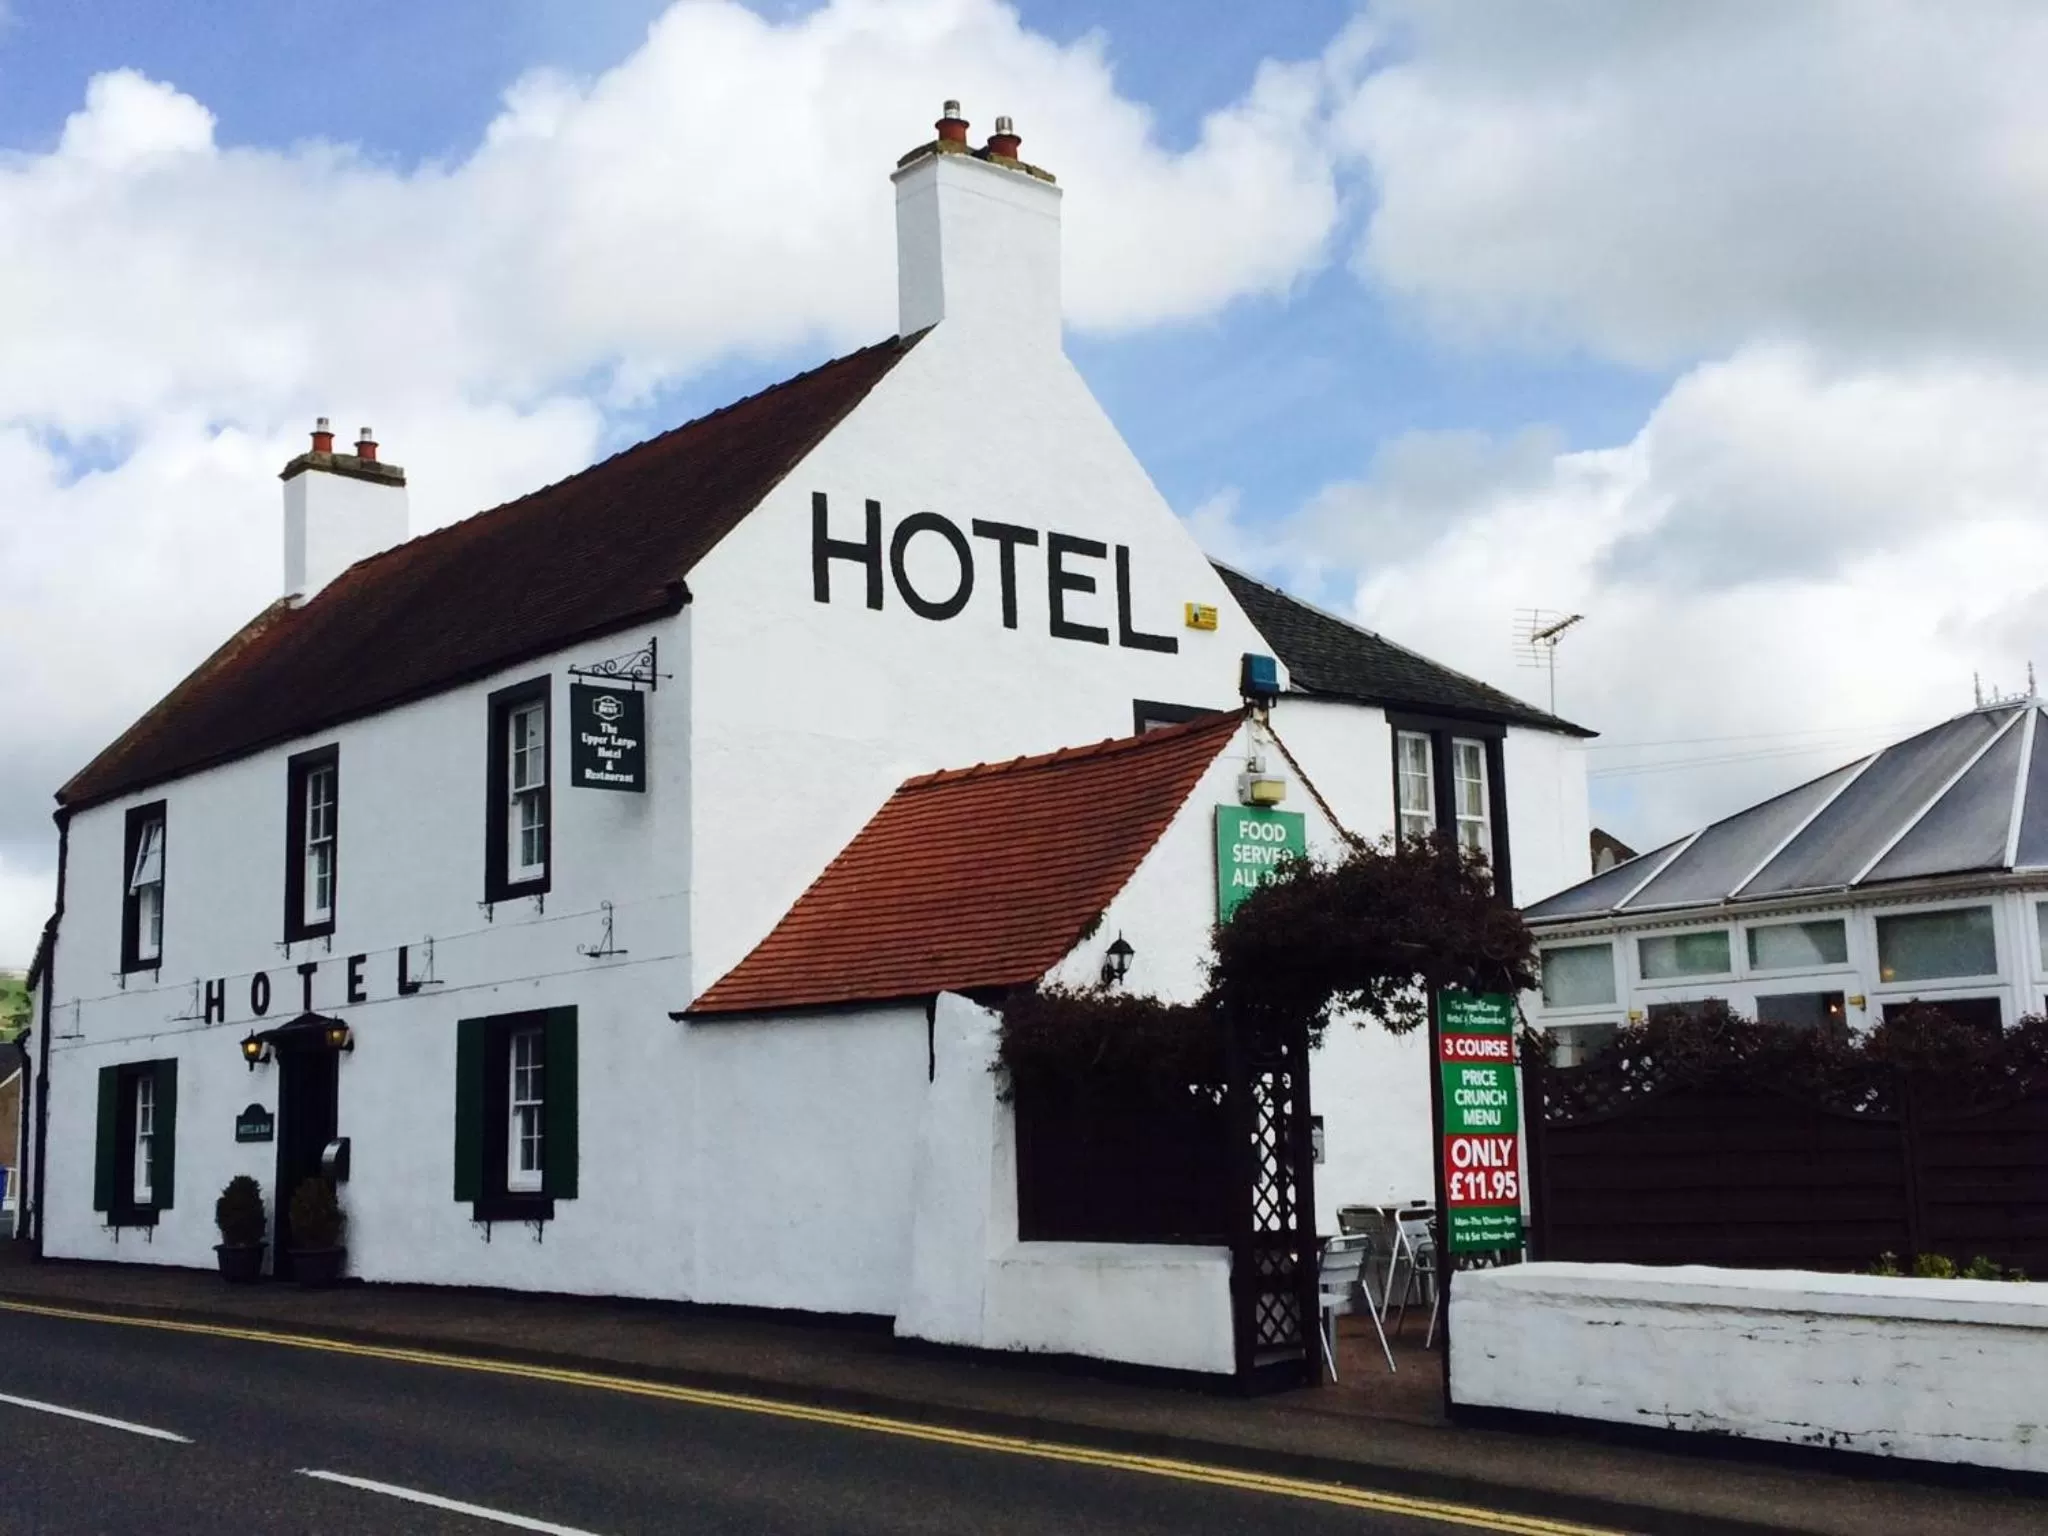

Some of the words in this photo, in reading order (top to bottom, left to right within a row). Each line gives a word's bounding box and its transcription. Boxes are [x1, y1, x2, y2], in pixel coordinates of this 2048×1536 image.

[812, 491, 1178, 654] HOTEL
[600, 722, 618, 734] The
[581, 732, 608, 746] Upper
[597, 746, 622, 759] Hotel
[584, 768, 634, 783] Restaurant
[1239, 820, 1287, 842] FOOD
[1232, 868, 1260, 887] ALL
[205, 945, 422, 1025] HOTEL
[1445, 1038, 1453, 1055] 3
[1456, 1038, 1508, 1057] COURSE
[1462, 1069, 1498, 1086] PRICE
[1454, 1088, 1508, 1105] CRUNCH
[1463, 1109, 1502, 1126] MENU
[1451, 1138, 1512, 1168] ONLY
[1450, 1170, 1517, 1200] £11.95
